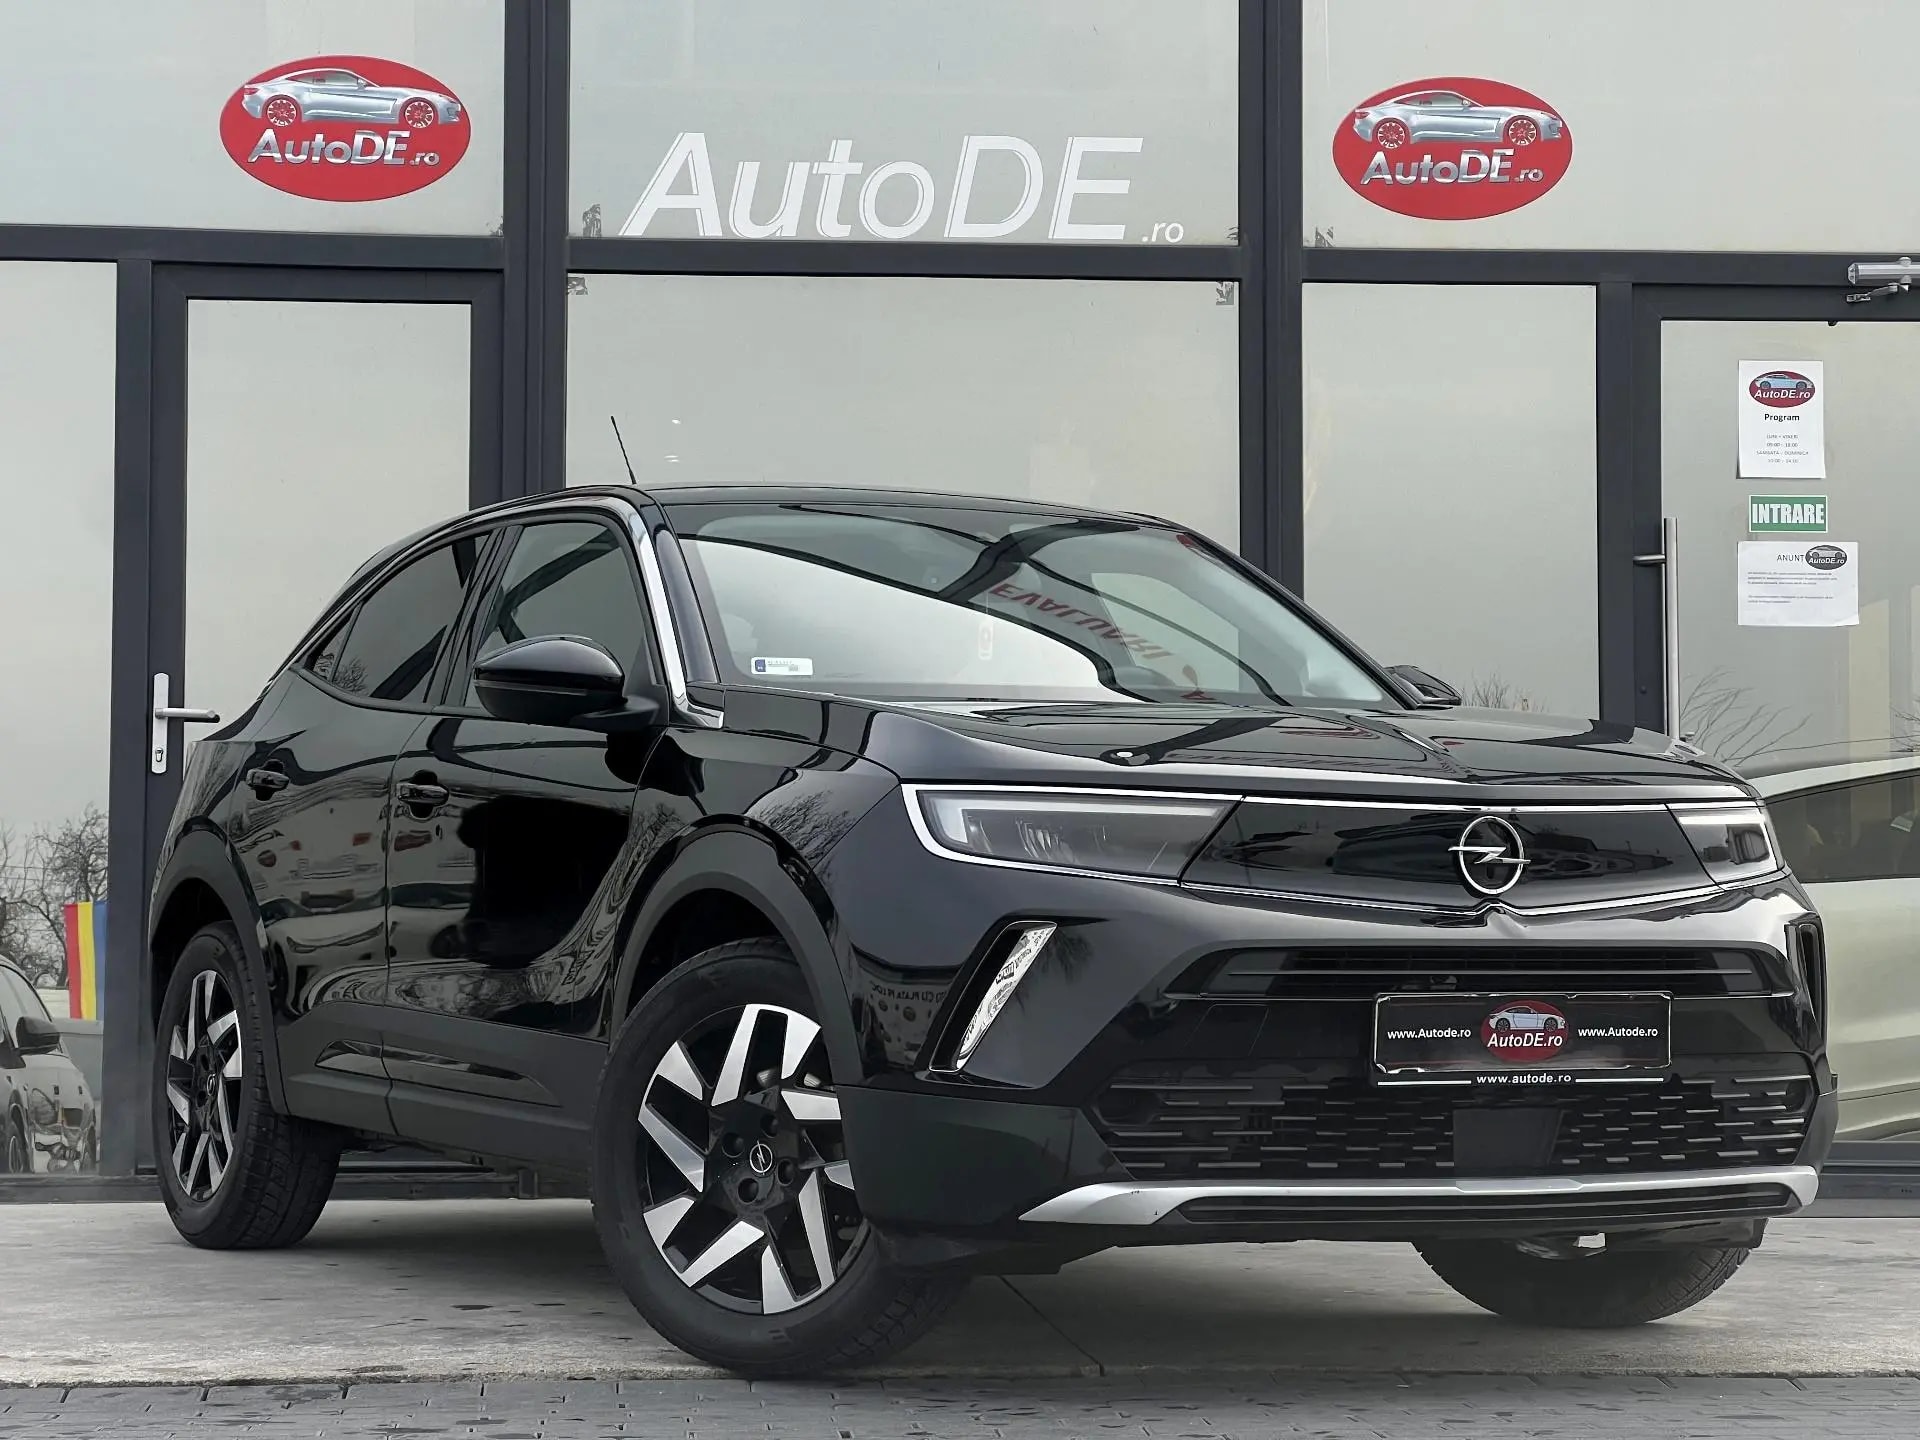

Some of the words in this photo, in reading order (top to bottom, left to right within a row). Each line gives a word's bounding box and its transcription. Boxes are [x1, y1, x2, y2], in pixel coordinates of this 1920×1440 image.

[1754, 389, 1811, 399] AutoDE.ro
[1764, 413, 1800, 423] Program
[1752, 503, 1825, 524] INTRARE
[1387, 1028, 1471, 1040] www.Autode.ro
[1578, 1027, 1658, 1038] www.Autode.ro
[1487, 1032, 1563, 1048] AutoDE.ro
[1476, 1073, 1572, 1084] www.autode.ro
